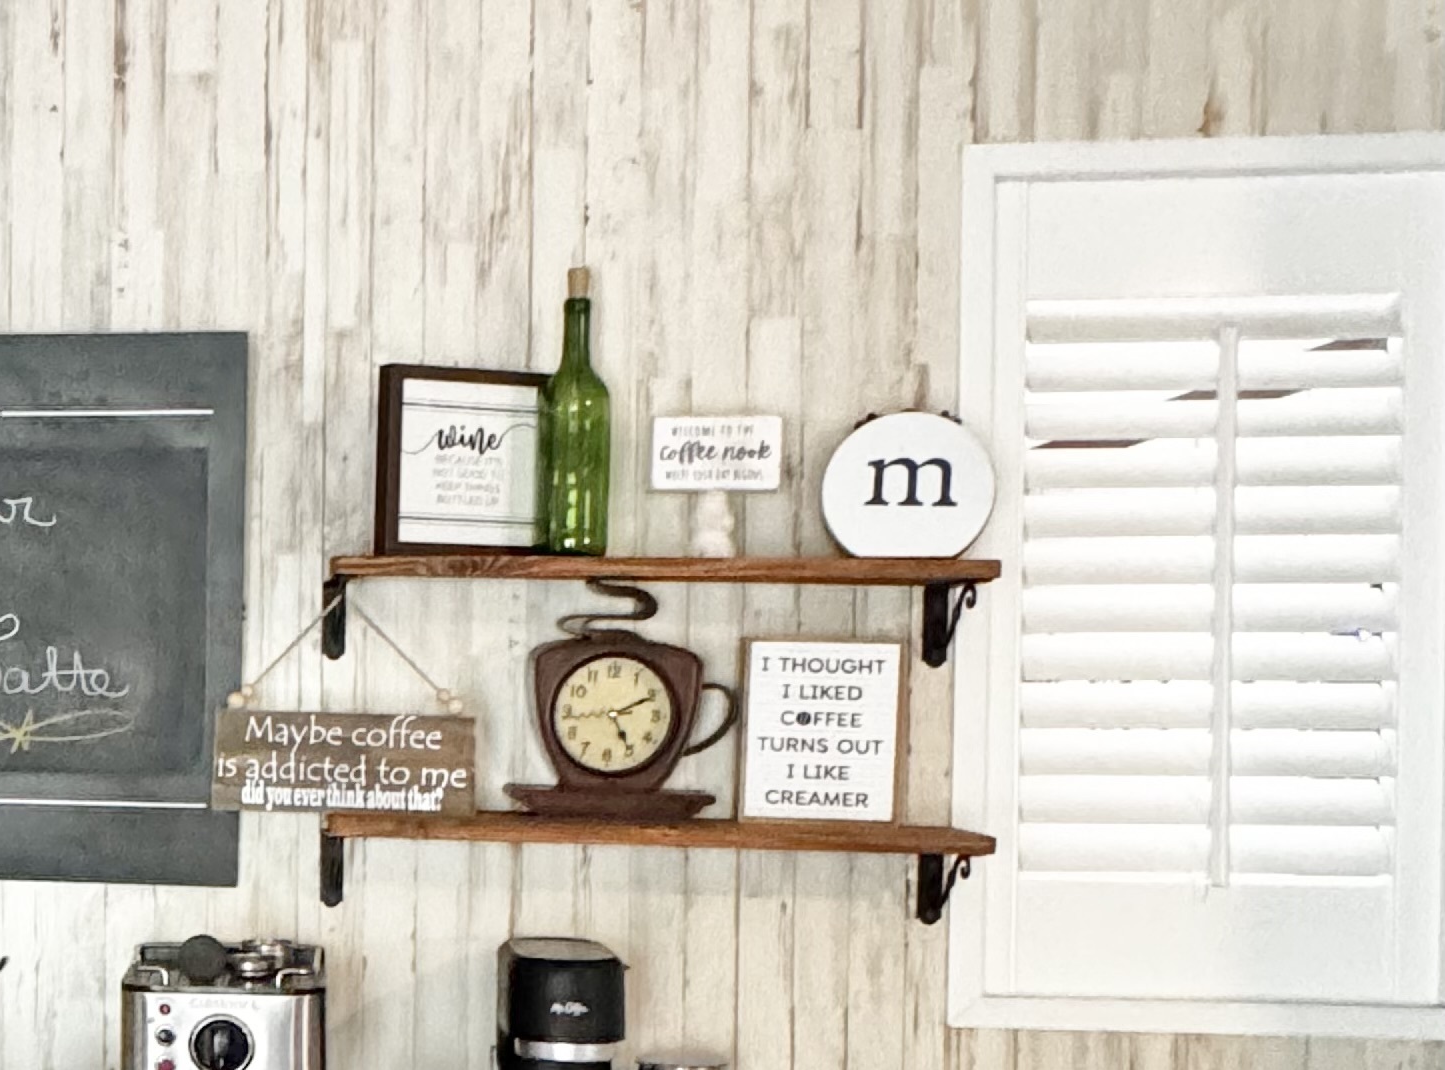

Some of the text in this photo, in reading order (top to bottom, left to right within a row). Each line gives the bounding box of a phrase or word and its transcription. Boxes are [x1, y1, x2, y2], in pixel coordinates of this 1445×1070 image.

[437, 424, 503, 455] wine
[659, 440, 773, 465] coffee nook
[864, 456, 958, 508] m
[761, 656, 887, 675] I THOUGHT
[569, 684, 587, 698] 10
[781, 683, 863, 701] I LIKED
[244, 714, 443, 756] Maybe coffee
[757, 736, 885, 756] TURNS OUT
[217, 751, 467, 788] is addicted to me
[786, 763, 851, 781] I LIKE
[241, 779, 445, 812] did you ever think about that?
[765, 789, 869, 808] CREAMER
